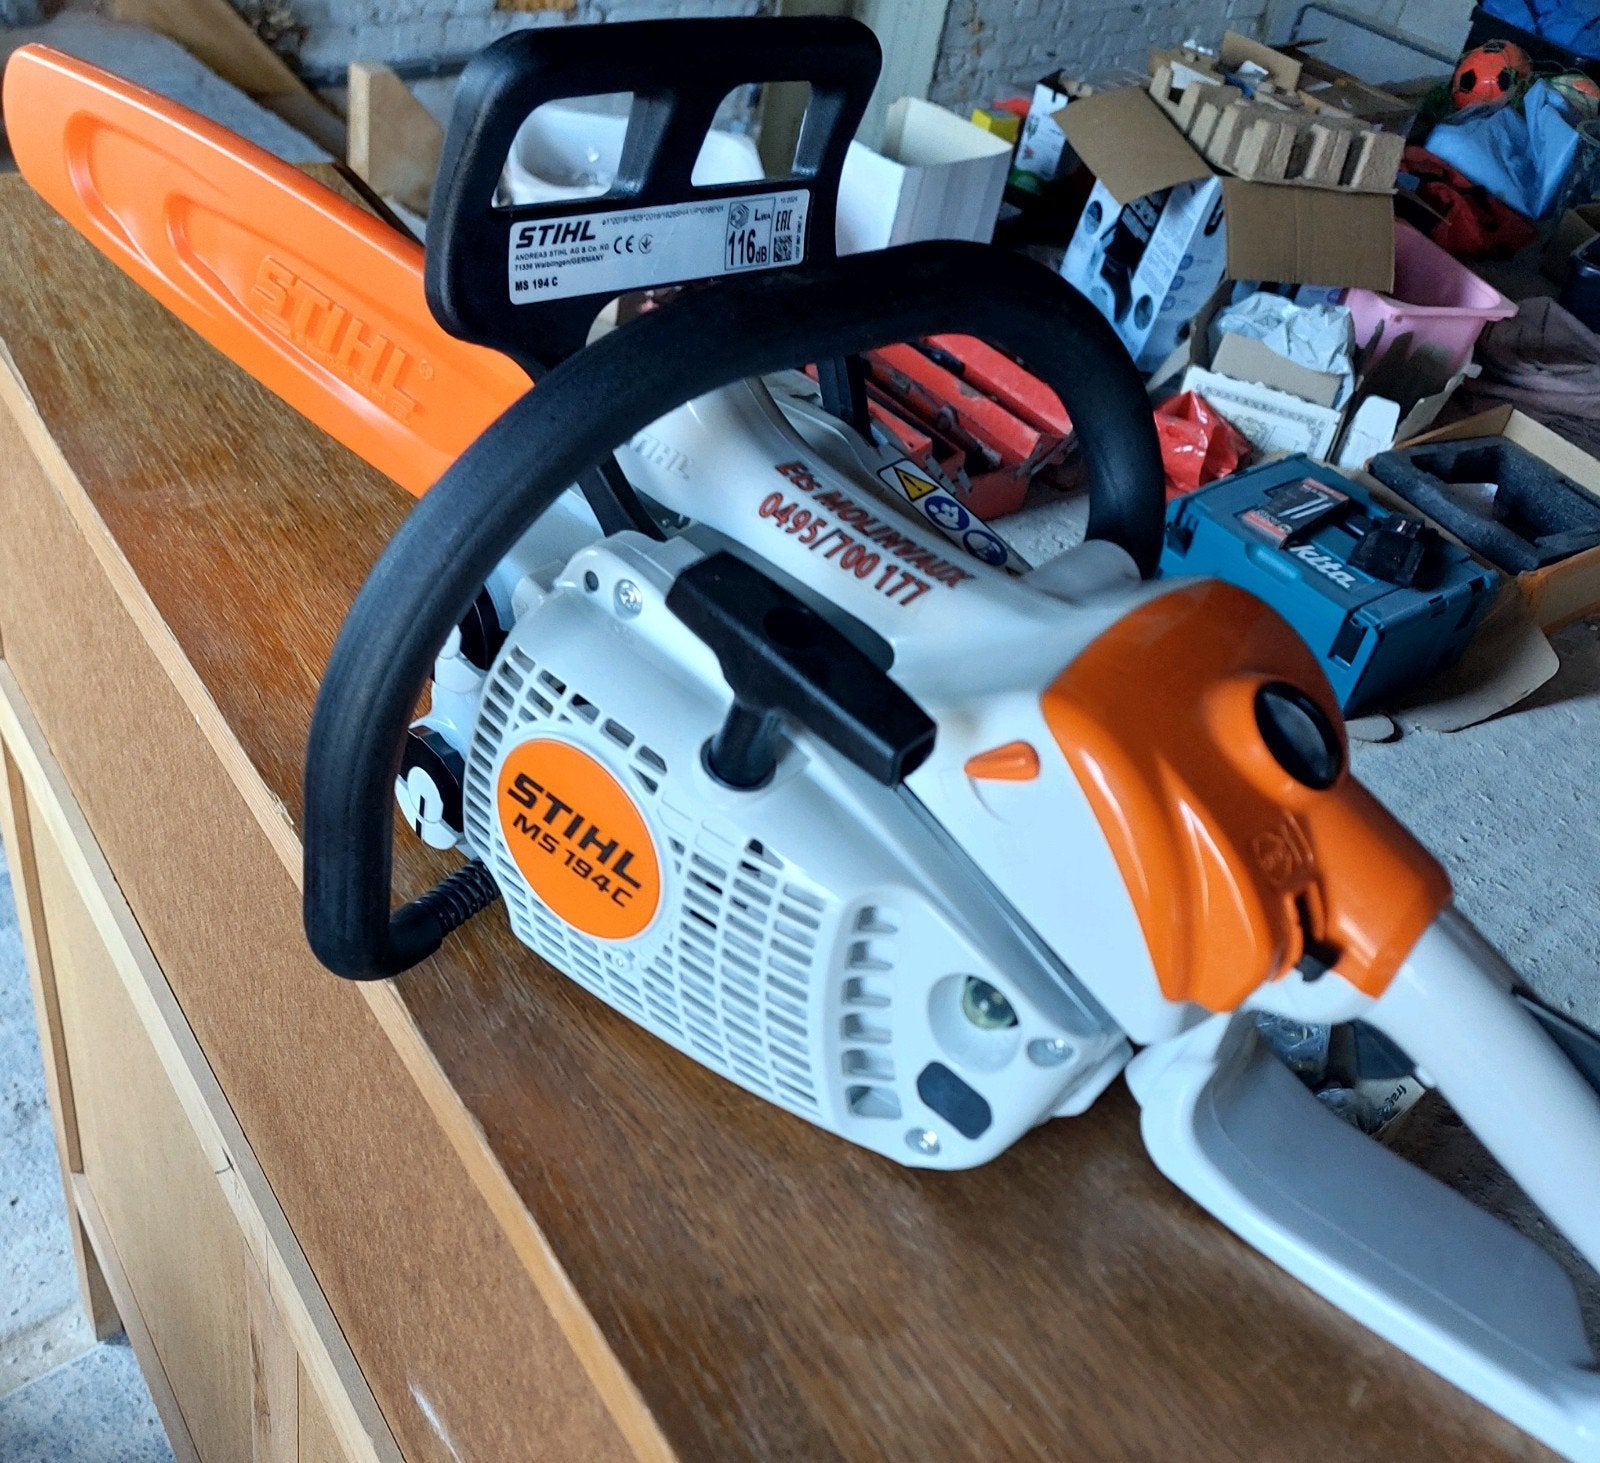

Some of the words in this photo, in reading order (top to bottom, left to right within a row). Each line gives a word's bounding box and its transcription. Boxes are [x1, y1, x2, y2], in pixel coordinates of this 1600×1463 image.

[515, 221, 596, 249] STIHL
[515, 251, 547, 261] ANDREAS
[549, 249, 568, 257] STIHL
[570, 246, 580, 254] AG
[515, 280, 529, 291] MS
[532, 278, 549, 289] 194
[551, 276, 558, 287] C
[251, 256, 423, 419] STIHL
[759, 491, 881, 579] 0495/700
[874, 564, 932, 606] 177
[812, 490, 976, 588] MOLINVAUX
[1289, 544, 1356, 590] kita
[507, 771, 642, 891] STIHL
[512, 812, 560, 855] MS
